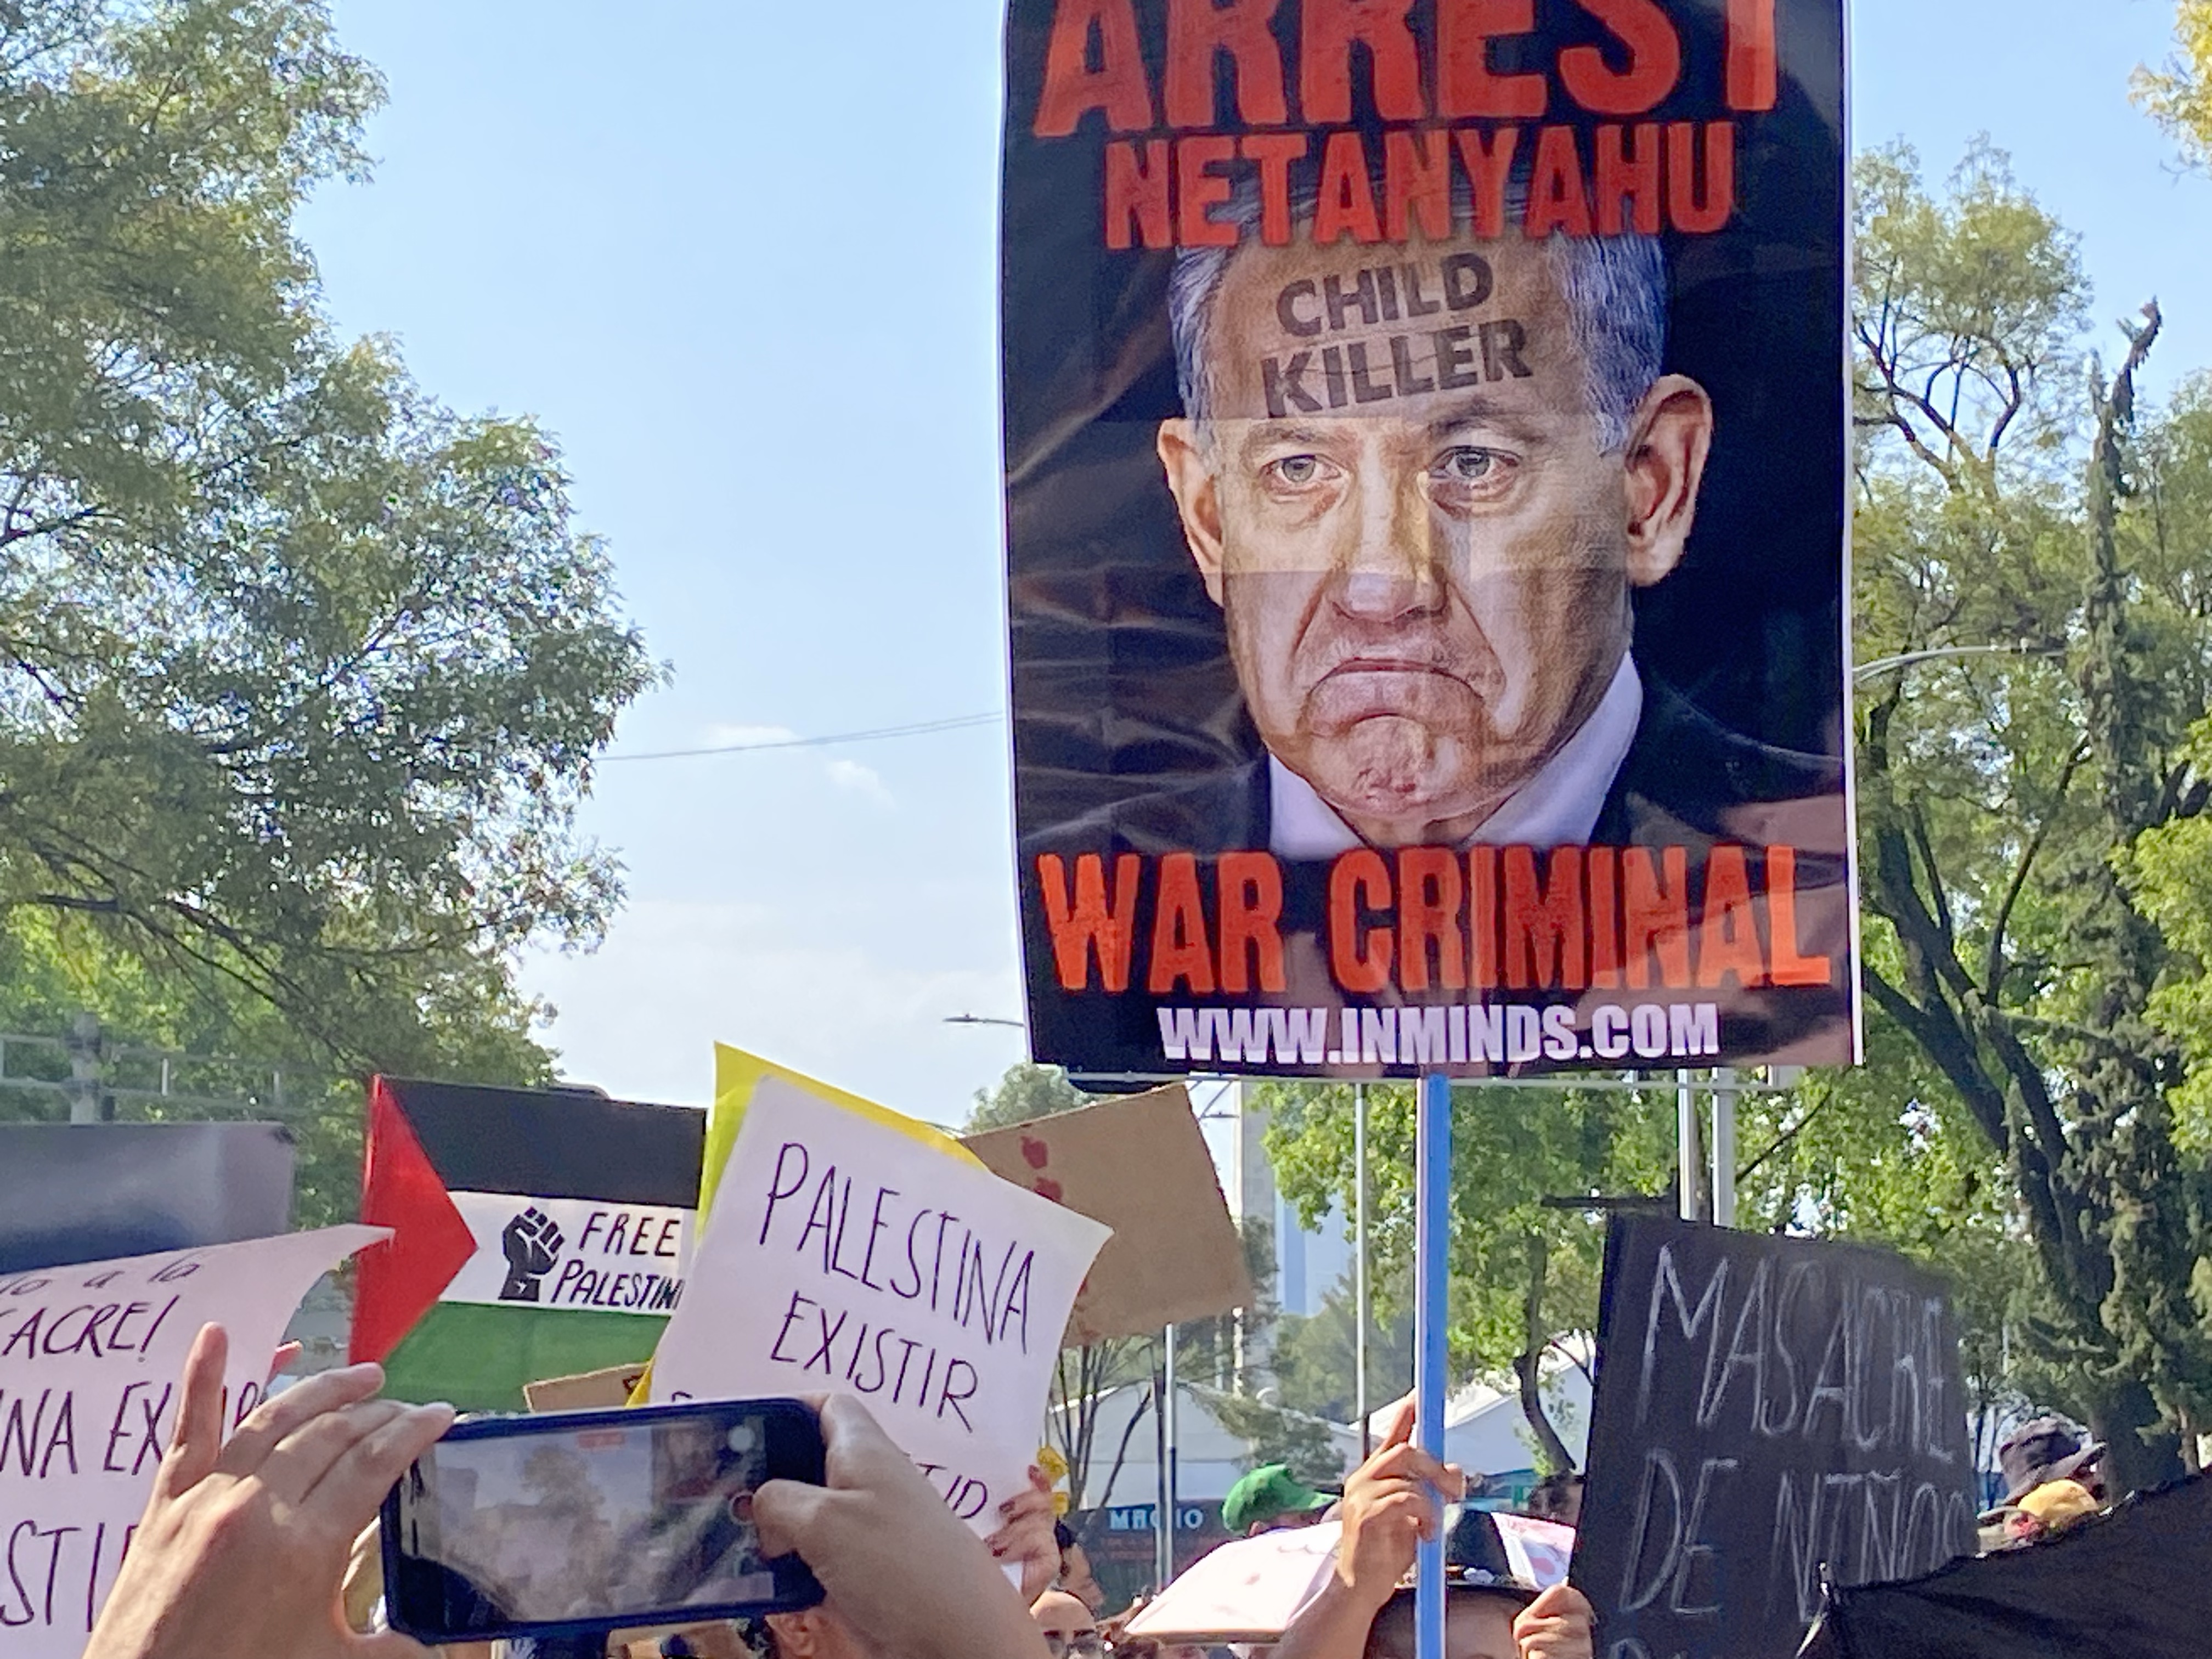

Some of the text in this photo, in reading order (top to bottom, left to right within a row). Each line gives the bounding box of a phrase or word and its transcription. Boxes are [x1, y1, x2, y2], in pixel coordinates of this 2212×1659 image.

[1032, 0, 1778, 137] ARREST
[1105, 121, 1735, 250] NETANYAHU
[1276, 252, 1494, 337] CHILD
[1262, 318, 1533, 418] KILLER
[1037, 850, 1287, 994] WAR
[1328, 845, 1831, 993] CRIMINAL
[1156, 1003, 1720, 1064] WWW.INMINDS.COM
[579, 1211, 680, 1257] FREE
[759, 1143, 1034, 1355] PALESTINA
[0, 1294, 180, 1363] ACRE!
[770, 1291, 979, 1432] EXISTIR
[0, 1389, 77, 1479] NA
[1618, 1447, 1739, 1616] DE
